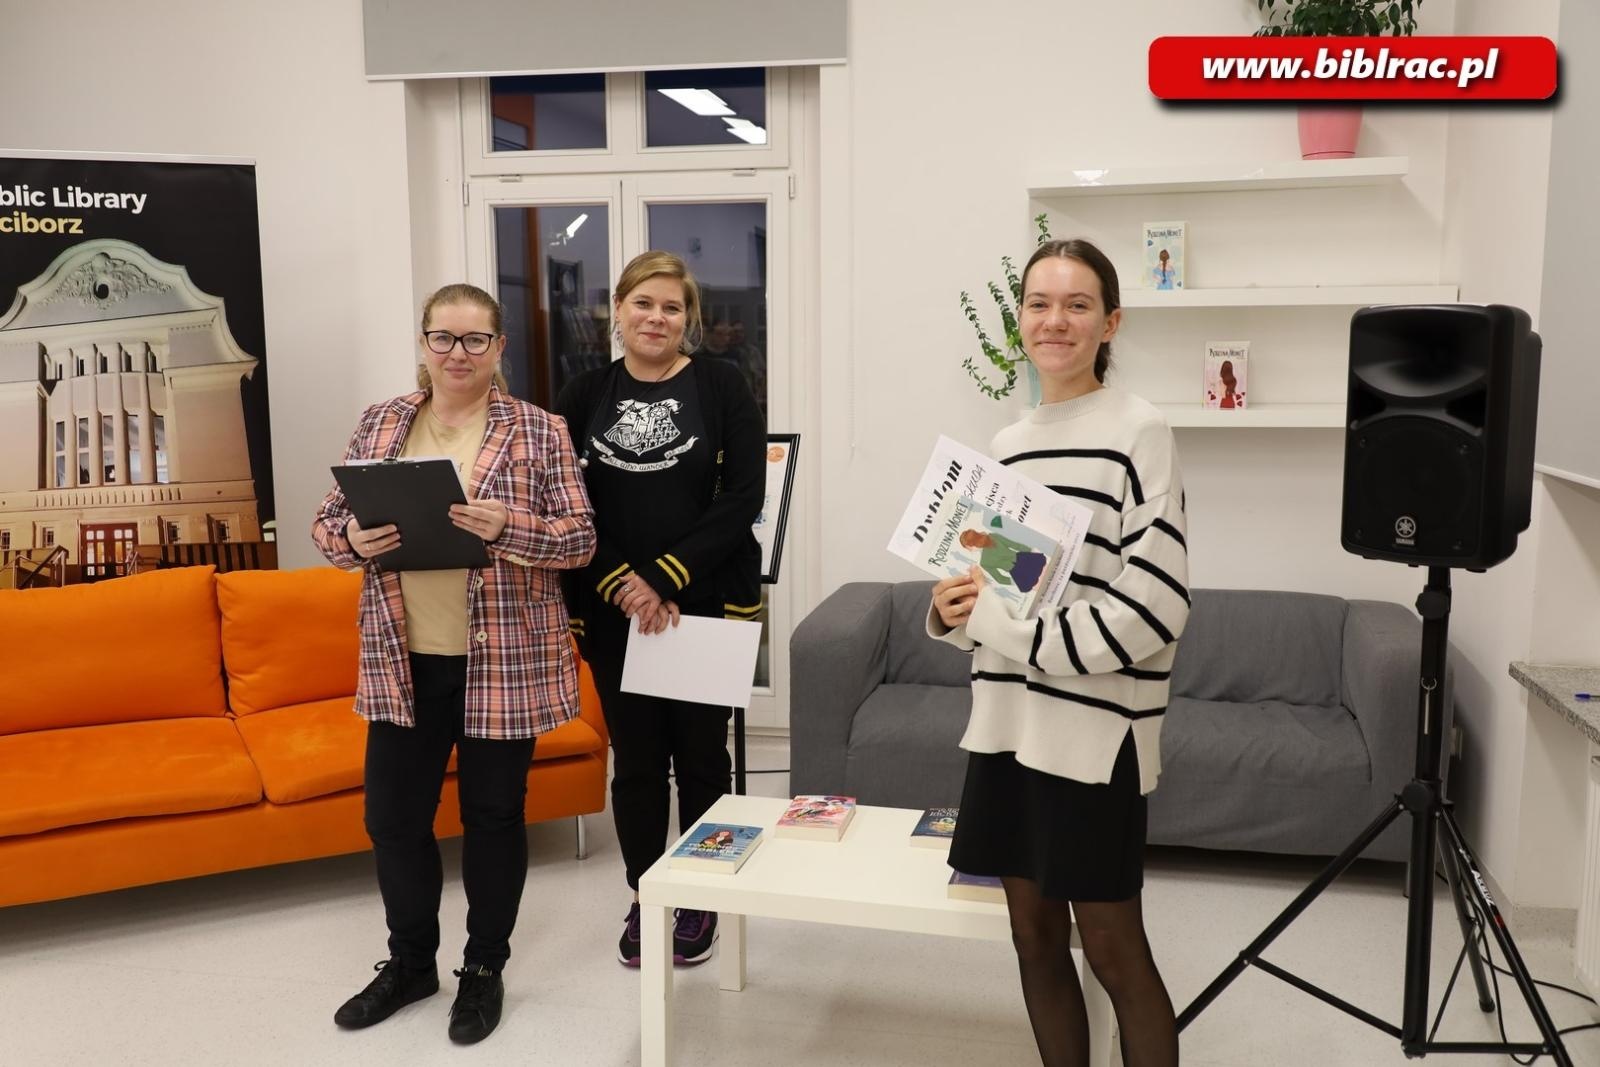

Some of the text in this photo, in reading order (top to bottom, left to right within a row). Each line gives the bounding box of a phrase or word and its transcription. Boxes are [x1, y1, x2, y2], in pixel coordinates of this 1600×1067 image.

[52, 185, 147, 215] Library
[0, 211, 84, 234] ciborz
[928, 500, 968, 567] RODZINA MONET
